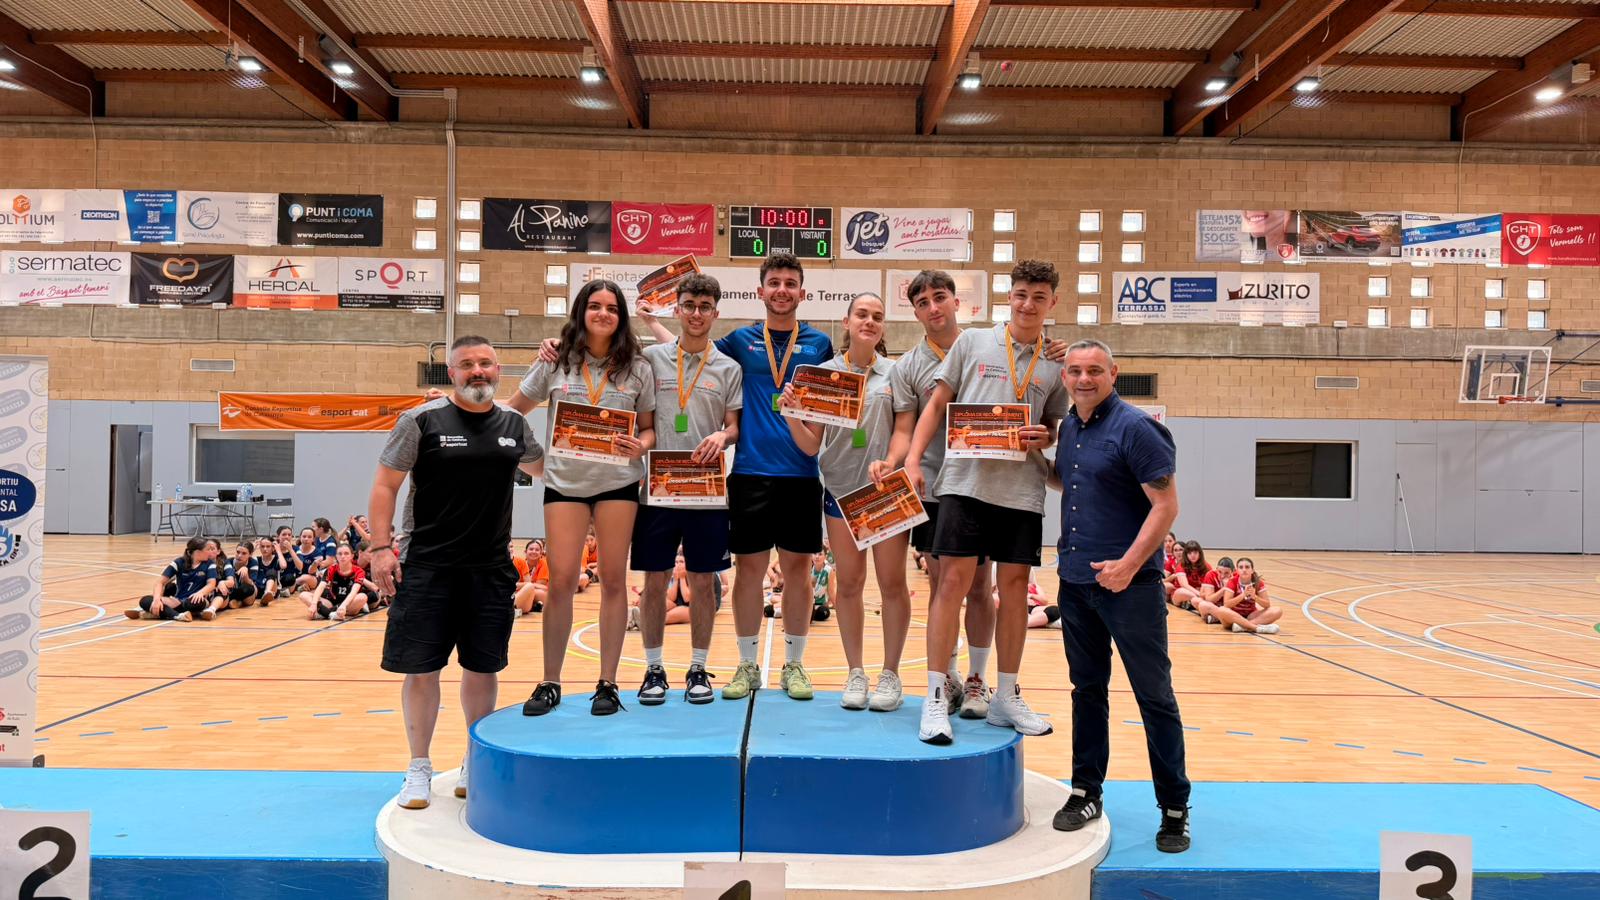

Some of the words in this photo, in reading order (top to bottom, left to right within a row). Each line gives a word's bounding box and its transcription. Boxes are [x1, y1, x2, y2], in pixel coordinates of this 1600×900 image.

[82, 211, 118, 219] DECATHLON
[306, 208, 336, 216] PUNT
[338, 208, 340, 216] i
[342, 208, 374, 217] COMA
[621, 212, 648, 222] CHT
[761, 209, 808, 226] 10:00
[507, 204, 526, 242] Al
[528, 205, 589, 233] Panino
[660, 215, 676, 224] Tots
[893, 217, 917, 229] Vine
[1224, 215, 1241, 224] 15%
[661, 226, 696, 236] Vermells
[844, 213, 889, 250] jet
[901, 230, 919, 239] amb
[1510, 226, 1536, 234] CHT
[1548, 225, 1564, 234] Tots
[738, 230, 760, 238] LOCAL
[800, 231, 826, 240] VISITANT
[1204, 233, 1236, 242] SOCIS
[1550, 235, 1584, 248] Vermells
[754, 239, 763, 254] 0
[817, 240, 827, 256] 0
[18, 254, 122, 272] sermatec
[592, 266, 650, 282] Fisiotas
[248, 280, 320, 292] HERCAL
[1118, 276, 1166, 302] ABC
[19, 288, 34, 298] amb
[720, 290, 758, 300] amen
[818, 290, 857, 301] Terras
[1244, 284, 1310, 300] ZURITO
[321, 408, 368, 418] esportcat
[0, 478, 18, 486] RTIU
[0, 500, 16, 512] SA
[187, 582, 193, 591] 7
[18, 826, 76, 900] 2
[1405, 850, 1457, 900] 3
